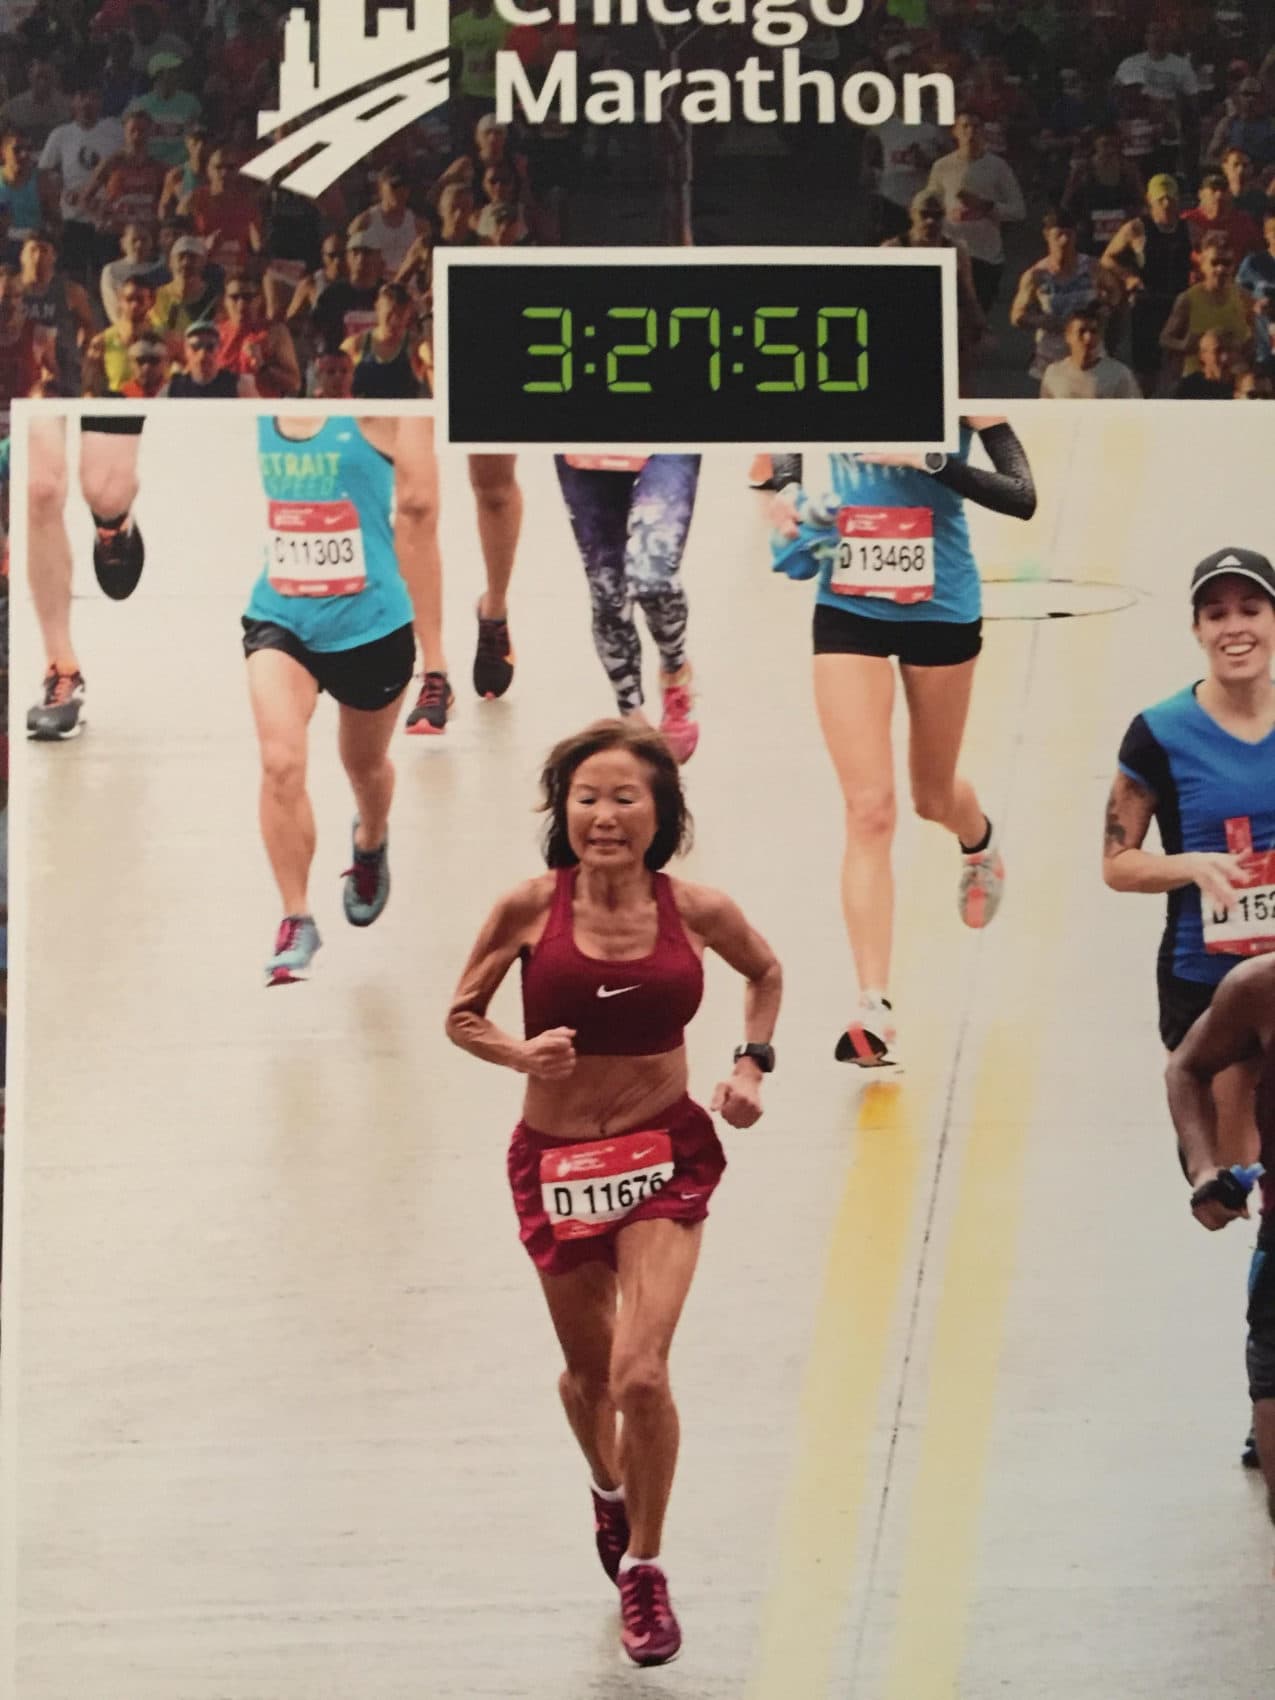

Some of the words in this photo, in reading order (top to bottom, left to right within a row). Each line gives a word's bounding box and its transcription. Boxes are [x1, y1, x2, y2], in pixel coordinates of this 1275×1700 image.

[495, 48, 955, 126] Marathon
[522, 307, 868, 392] 3:27:50
[289, 537, 354, 565] 11303
[860, 545, 926, 572] 13468
[553, 1187, 573, 1216] D
[583, 1172, 664, 1214] 11676
